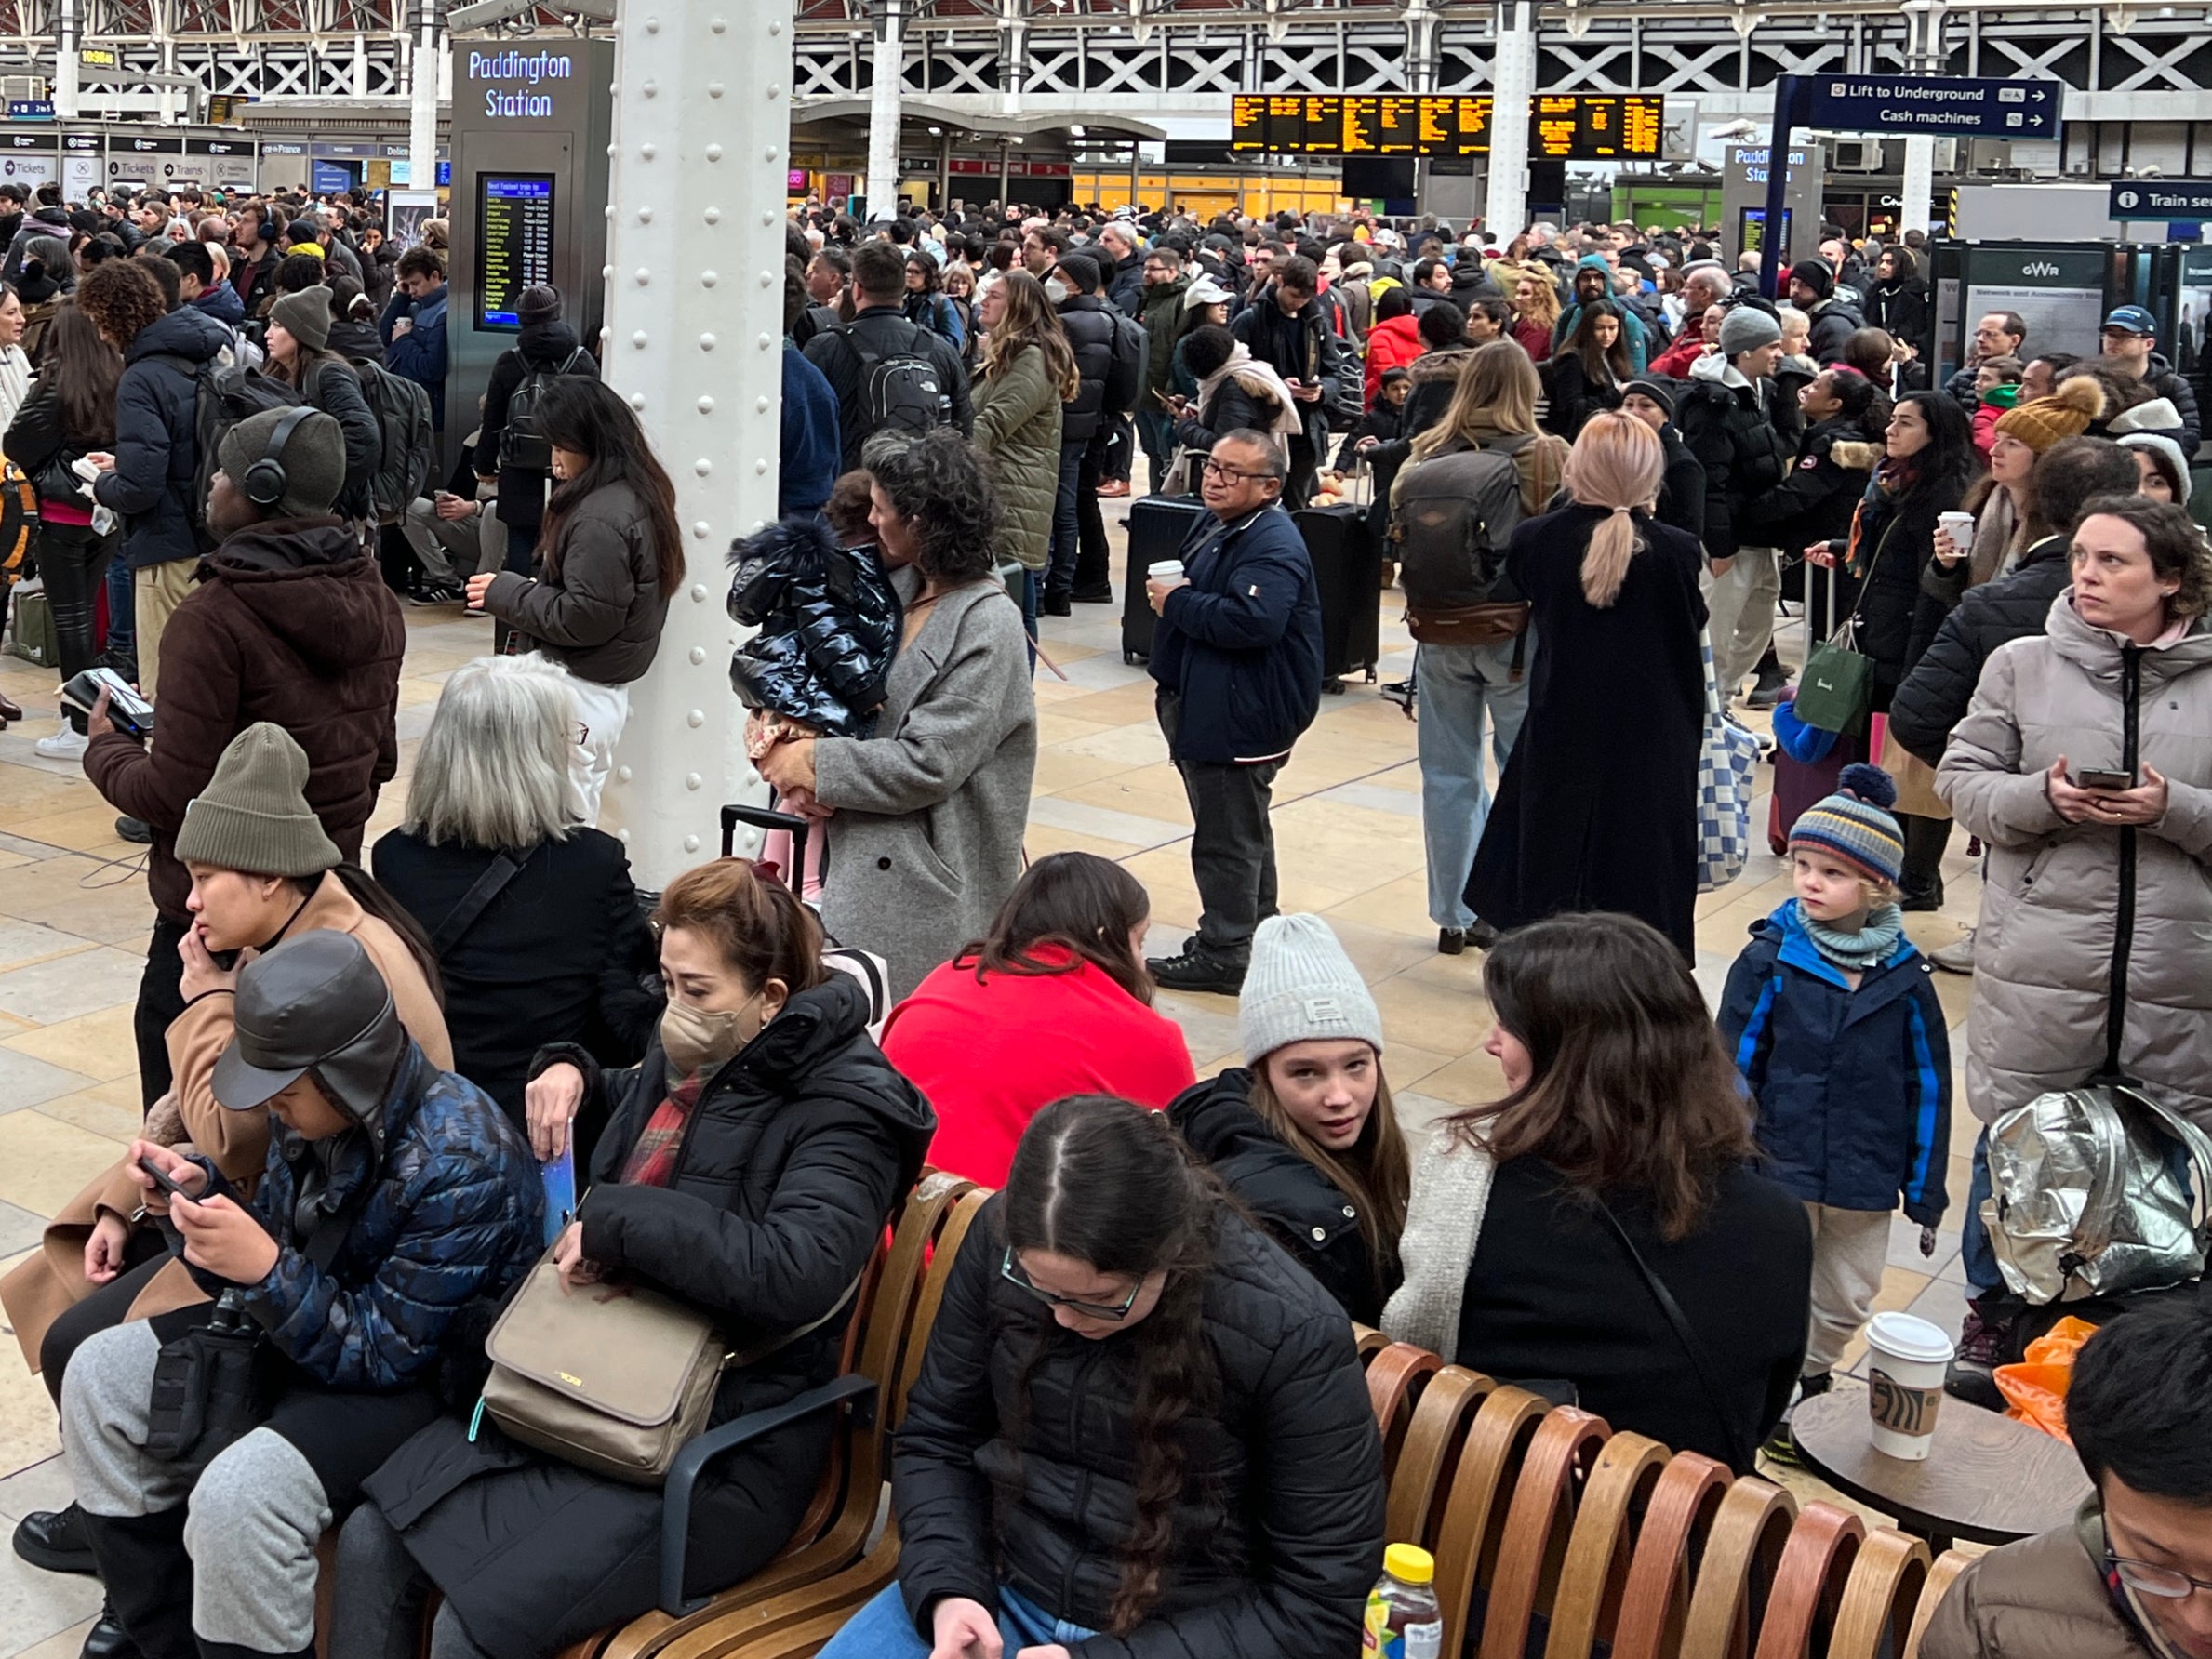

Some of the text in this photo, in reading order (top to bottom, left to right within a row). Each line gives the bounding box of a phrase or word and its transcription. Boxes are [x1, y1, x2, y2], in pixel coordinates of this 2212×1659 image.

[469, 50, 572, 84] Paddington
[1849, 85, 1985, 102] Lift to Underground
[485, 89, 552, 117] Station
[1879, 109, 1981, 126] Cash machines
[278, 145, 301, 154] France
[1735, 149, 1805, 165] Paddion
[17, 163, 45, 174] Tickets
[122, 163, 155, 174] Tickets
[176, 165, 203, 175] Trains
[2149, 193, 2188, 206] Train
[2022, 261, 2060, 277] GWR
